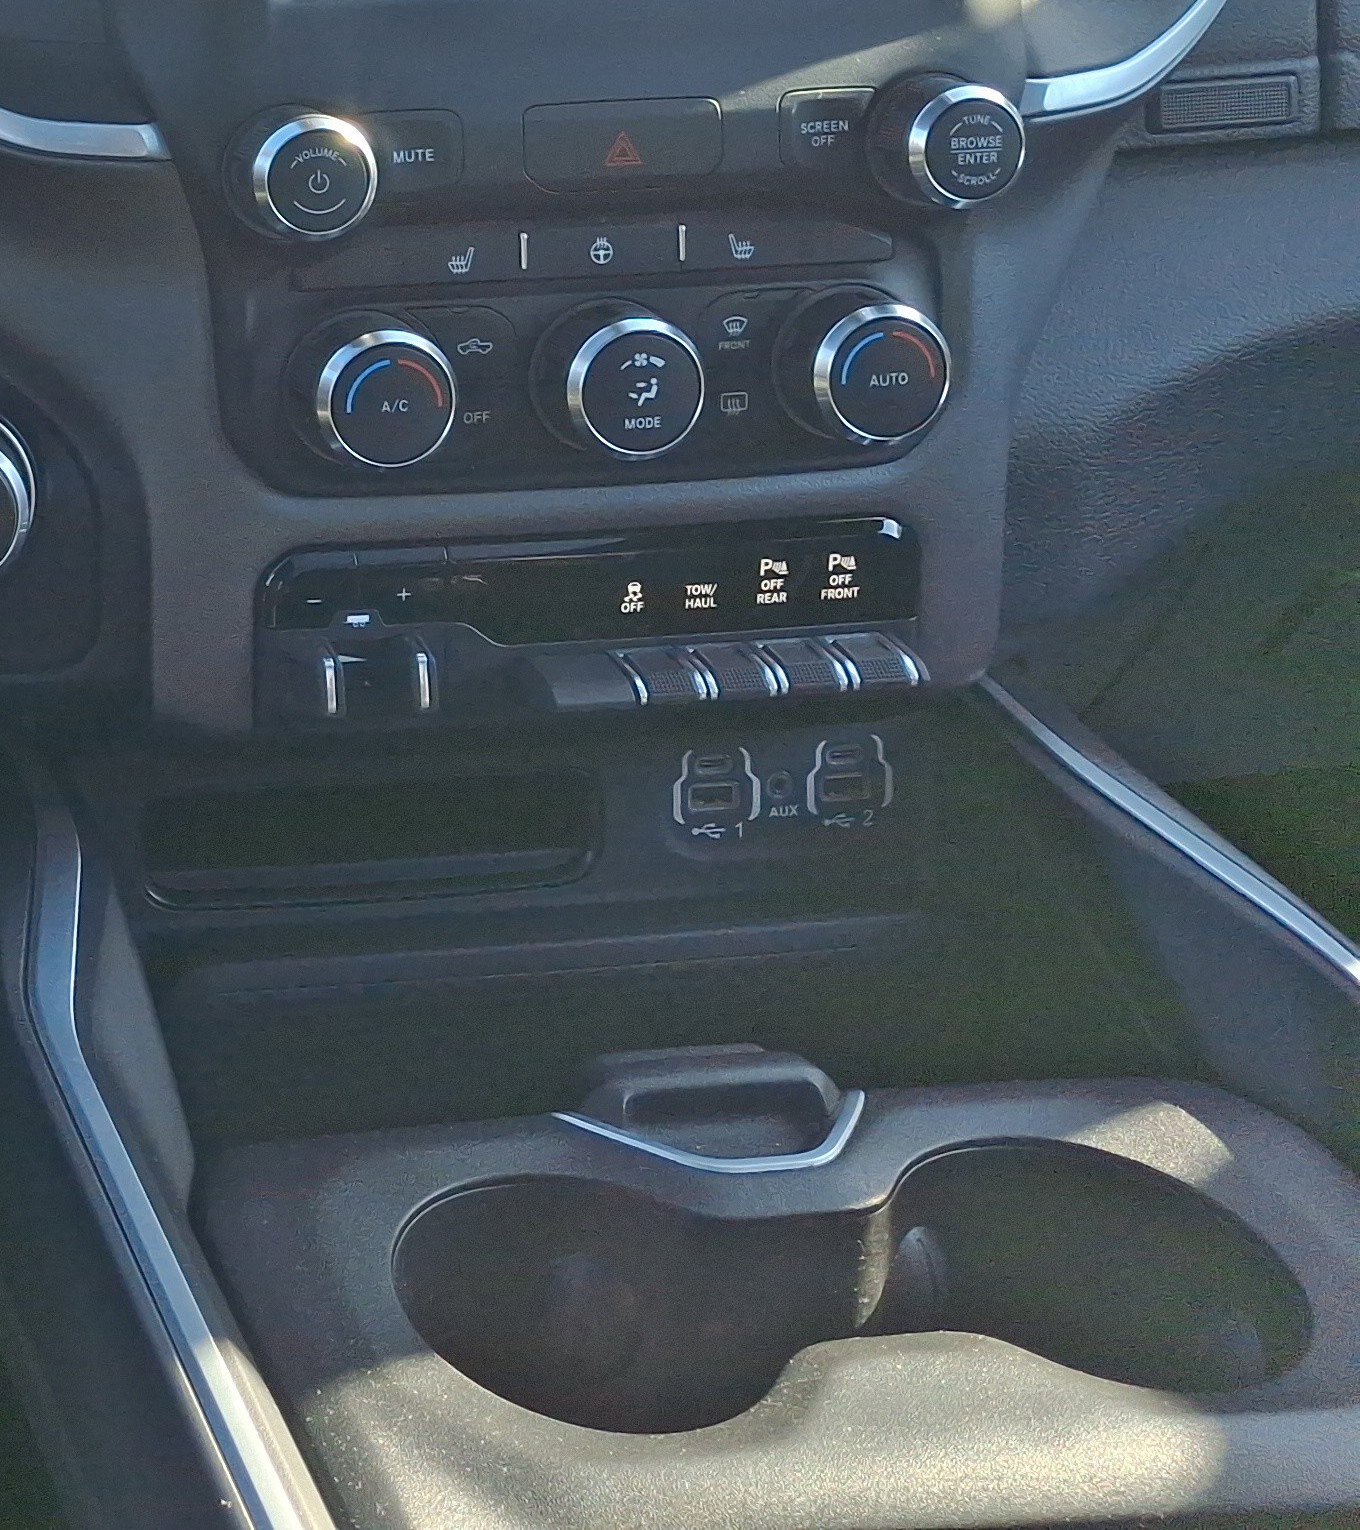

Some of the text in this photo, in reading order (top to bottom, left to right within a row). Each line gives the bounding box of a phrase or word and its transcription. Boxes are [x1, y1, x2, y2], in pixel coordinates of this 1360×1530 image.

[962, 113, 991, 127] TUNE
[799, 120, 850, 137] SCREEN
[811, 133, 836, 148] OFF
[949, 134, 1003, 150] BROWSE
[294, 146, 342, 165] VOLUME
[392, 147, 436, 165] MUTE
[956, 150, 998, 165] ENTER
[957, 170, 998, 187] SCROLL
[868, 372, 910, 389] AUTO
[381, 398, 409, 414] A/C
[463, 409, 491, 425] OFF
[623, 414, 663, 432] MODE
[760, 578, 785, 591] OFF
[829, 573, 853, 587] OFF
[685, 582, 718, 597] TOW/
[820, 586, 861, 600] FRONT
[685, 596, 718, 610] HAUL
[756, 591, 788, 605] REAR
[620, 601, 645, 614] OFF
[769, 804, 800, 820] AUX
[862, 808, 875, 827] 2
